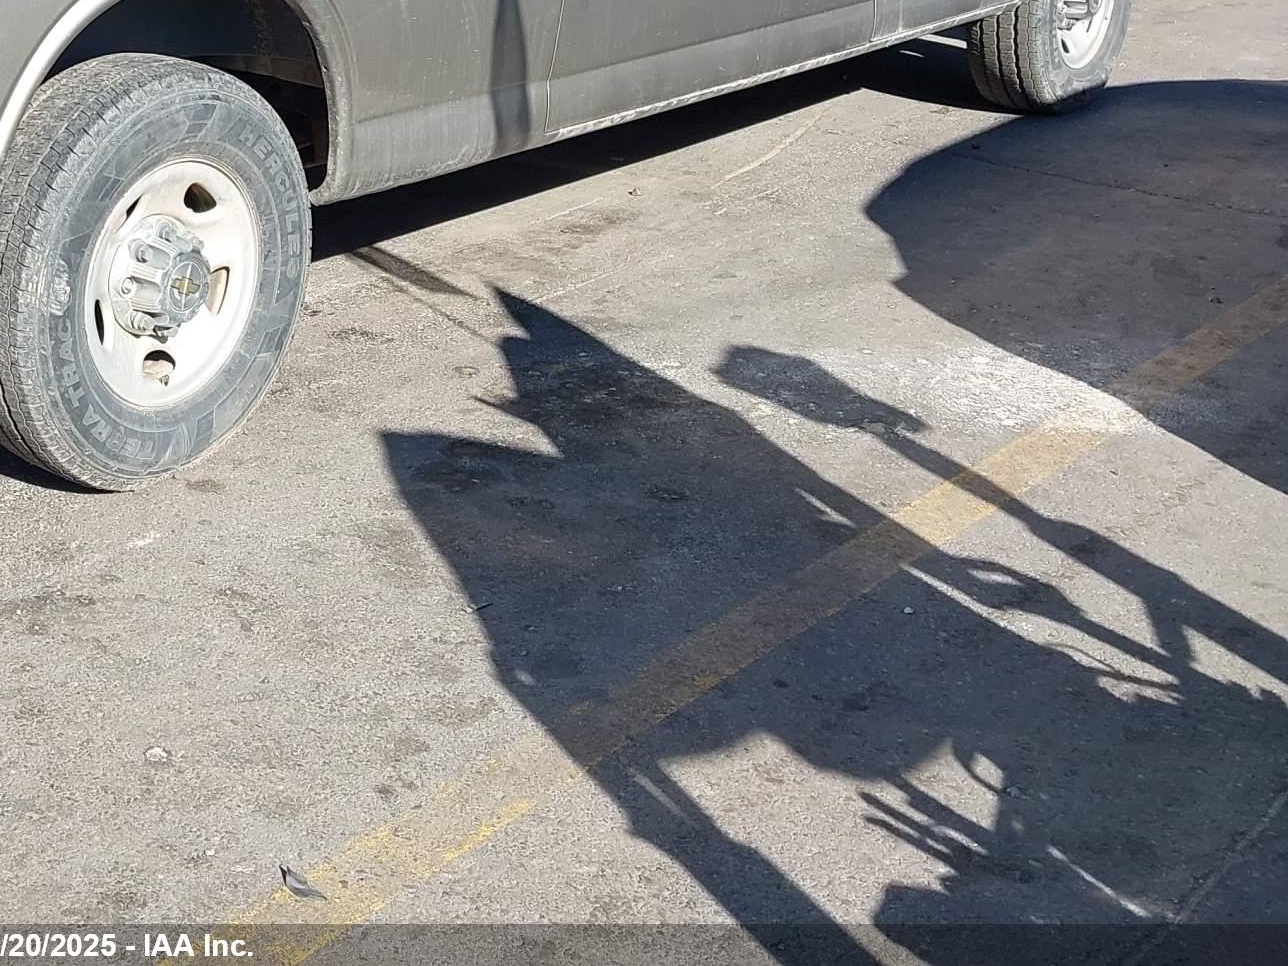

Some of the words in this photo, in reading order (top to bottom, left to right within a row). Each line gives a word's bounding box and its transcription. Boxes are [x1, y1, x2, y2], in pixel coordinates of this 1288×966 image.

[239, 124, 302, 279] HERCULES
[57, 317, 86, 409] TRAC
[82, 403, 154, 460] TERRA
